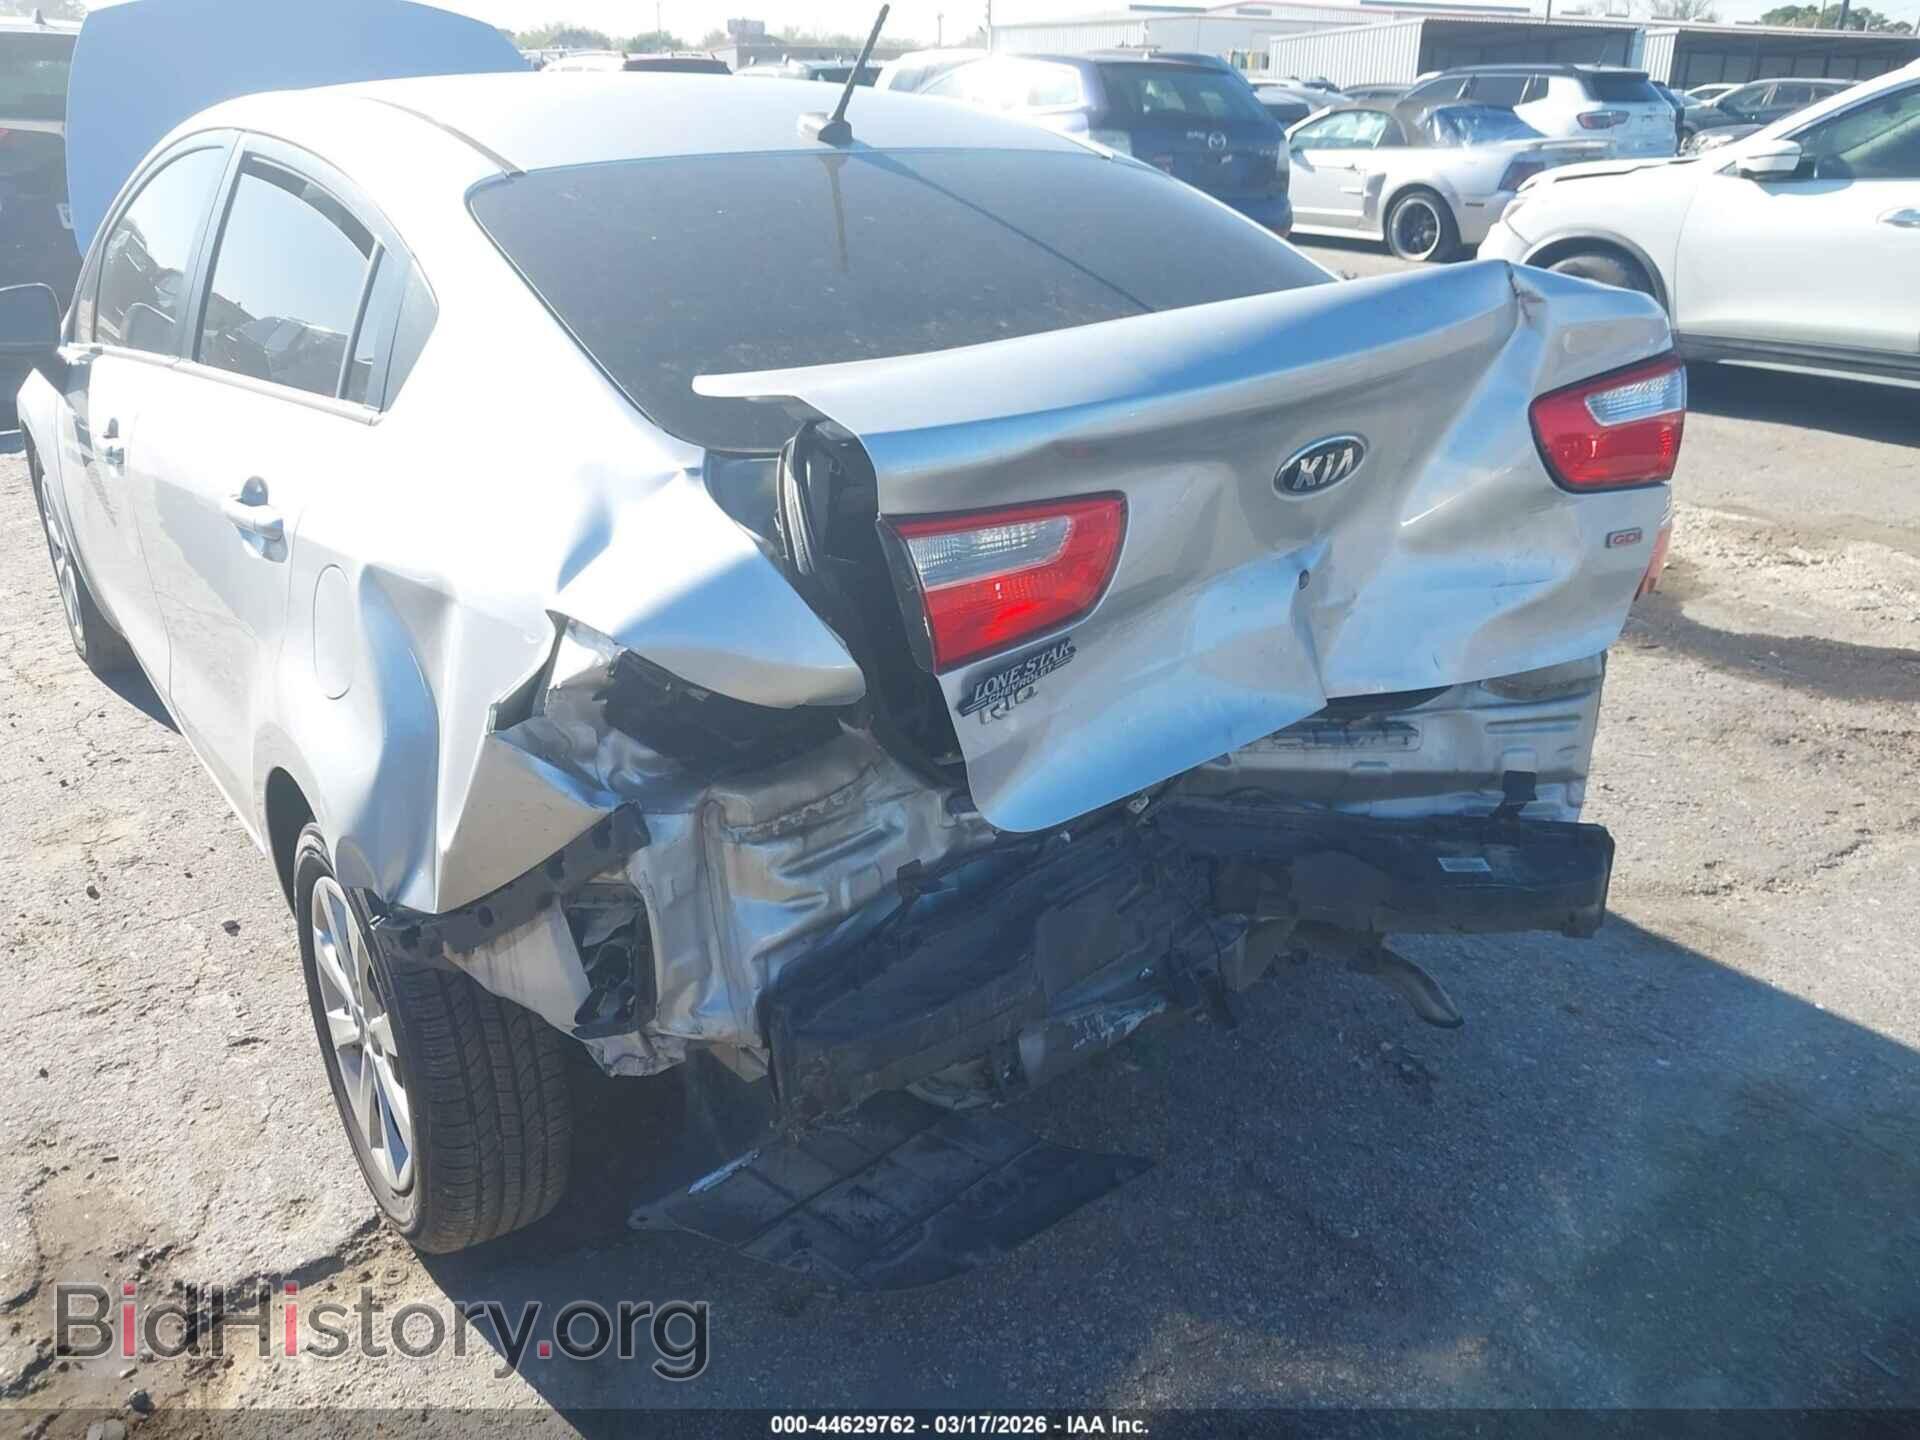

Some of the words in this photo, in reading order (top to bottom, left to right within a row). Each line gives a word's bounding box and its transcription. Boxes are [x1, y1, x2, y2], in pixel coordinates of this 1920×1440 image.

[1293, 447, 1353, 489] KIA
[974, 664, 1023, 701] LONE
[1023, 640, 1073, 676] STAR
